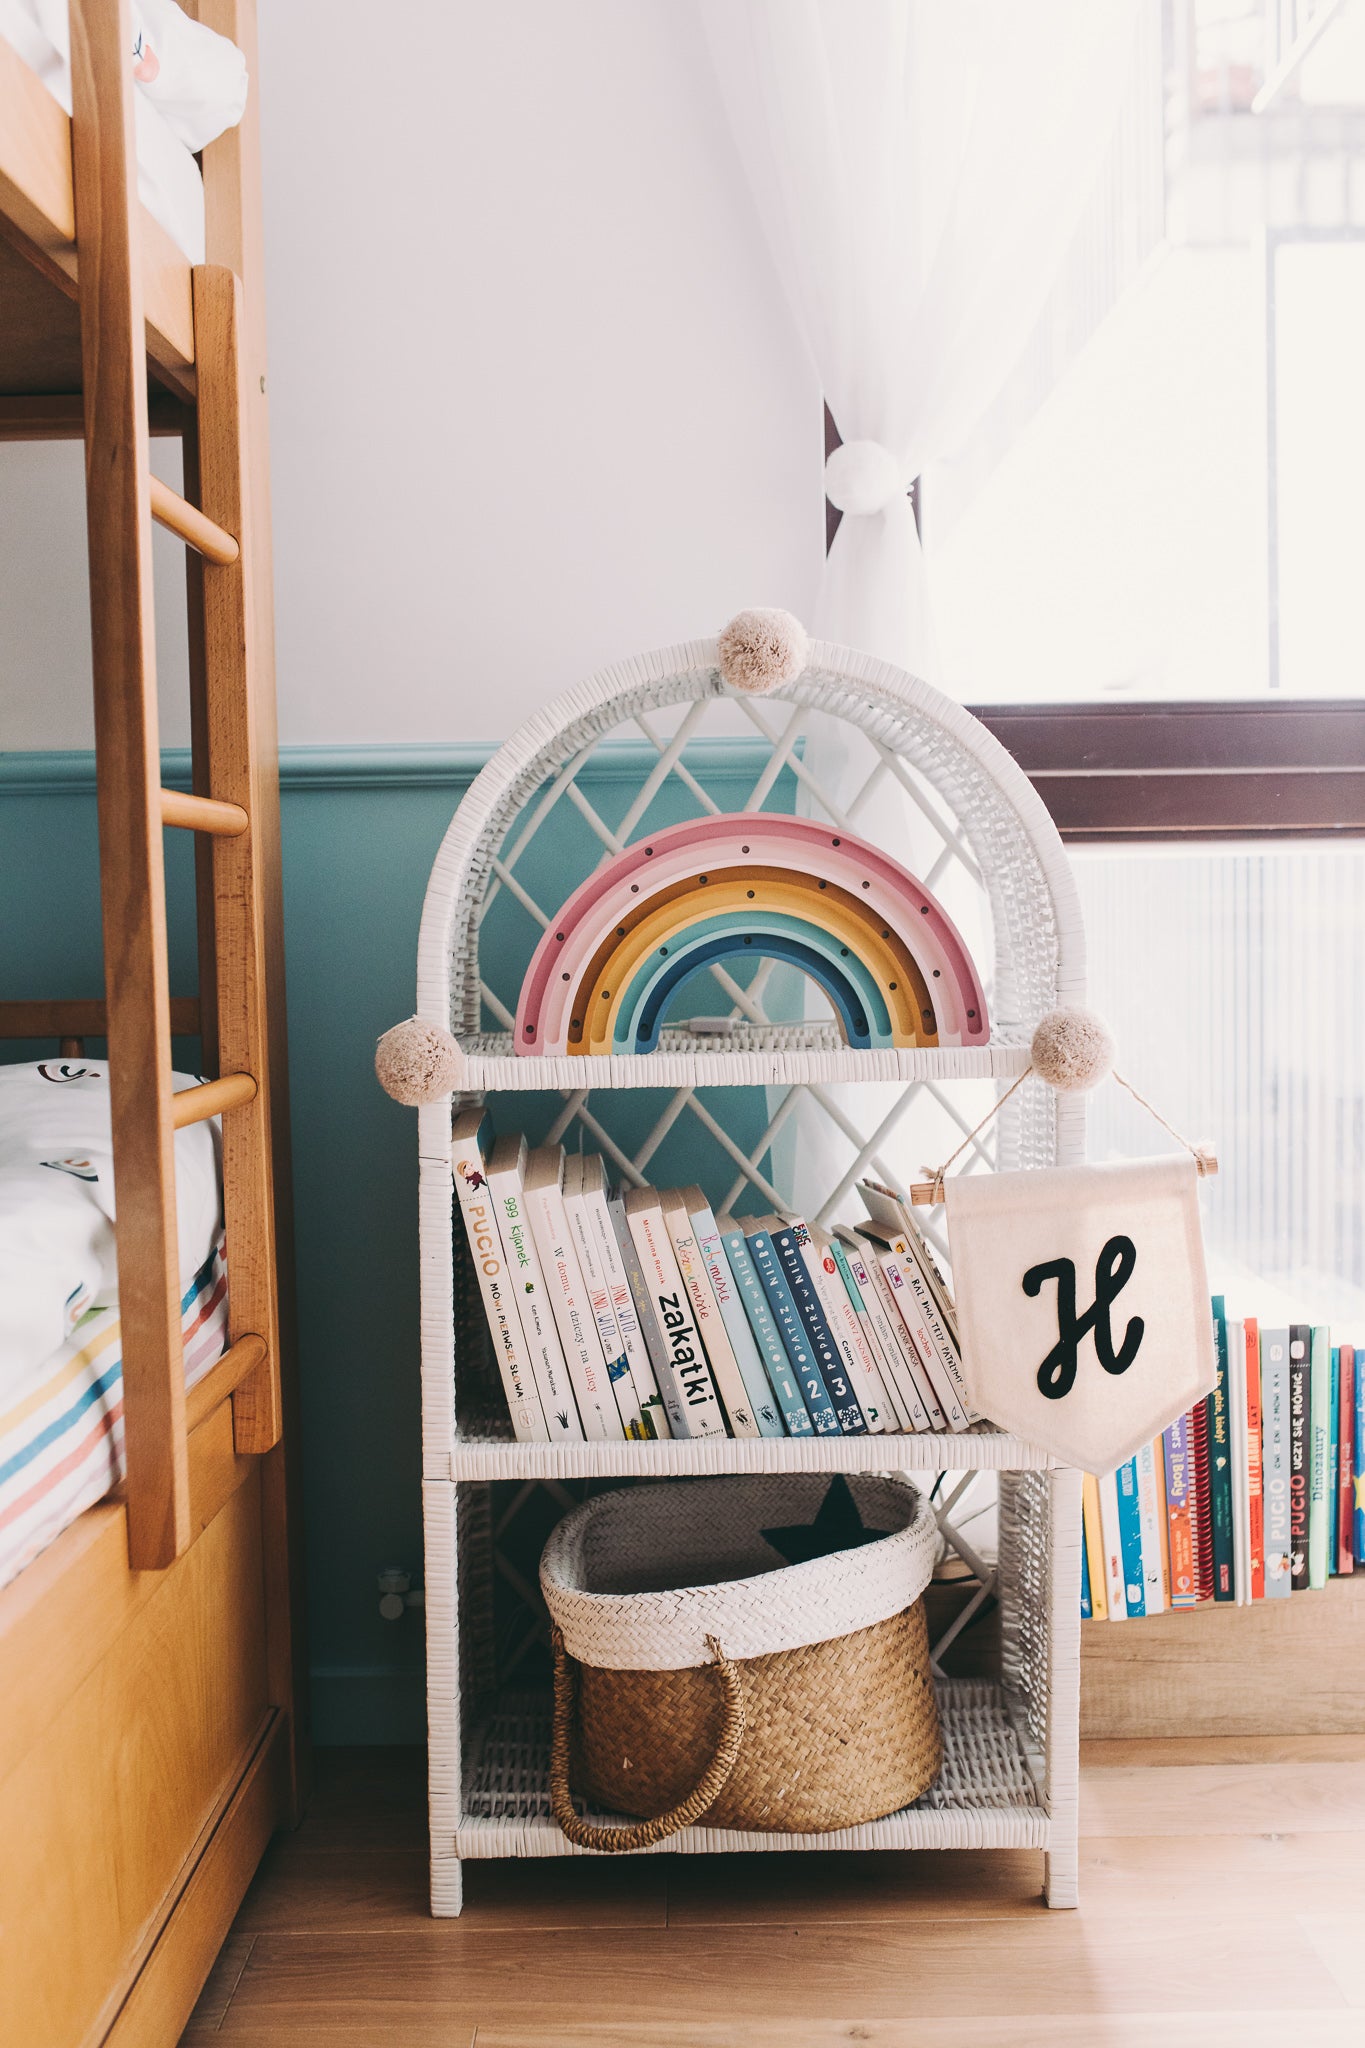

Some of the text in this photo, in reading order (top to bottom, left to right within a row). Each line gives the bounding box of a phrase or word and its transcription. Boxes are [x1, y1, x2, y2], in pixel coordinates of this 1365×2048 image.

[504, 1198, 530, 1268] 999 kijanek
[554, 1247, 564, 1257] W
[643, 1220, 665, 1284] Michalina Rolnik
[731, 1239, 753, 1286] NIEBO
[756, 1240, 778, 1286] NIEBO
[781, 1238, 803, 1284] NIEBO
[557, 1262, 570, 1294] domu,
[676, 1237, 711, 1319] Różnimisie
[568, 1298, 574, 1306] w
[1022, 1235, 1144, 1399] H
[580, 1350, 588, 1363] na
[659, 1293, 714, 1404] zakątki
[842, 1341, 854, 1366] Colors
[887, 1343, 900, 1367] mniam
[917, 1328, 932, 1358] kocham
[510, 1365, 523, 1398] SŁOWA
[585, 1367, 596, 1391] ulicy
[782, 1381, 792, 1398] 1
[807, 1380, 821, 1399] 2
[832, 1377, 846, 1396] 3
[1293, 1441, 1302, 1471] UCZY
[1311, 1425, 1326, 1502] Dinozaury
[1171, 1464, 1187, 1497] Body
